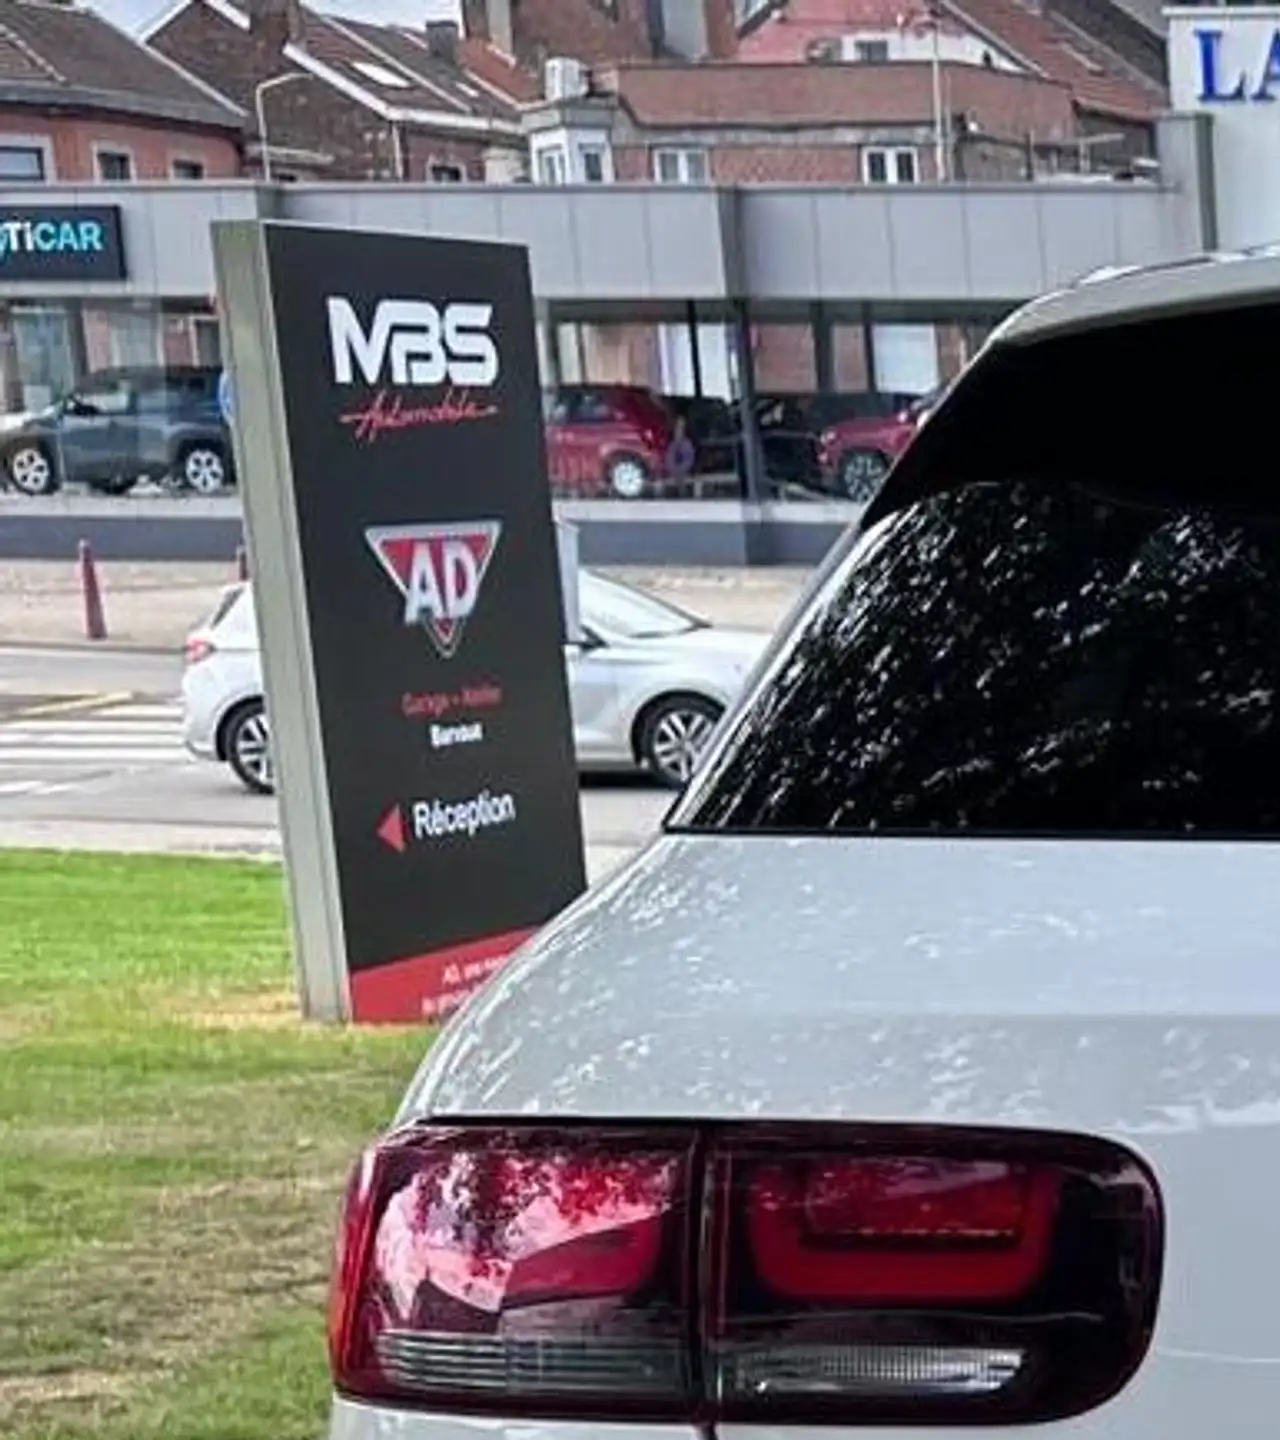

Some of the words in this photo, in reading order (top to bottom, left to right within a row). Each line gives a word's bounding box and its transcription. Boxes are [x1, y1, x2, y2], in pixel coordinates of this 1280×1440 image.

[328, 296, 499, 386] MBS
[405, 539, 479, 625] AD
[412, 788, 516, 839] Réception
